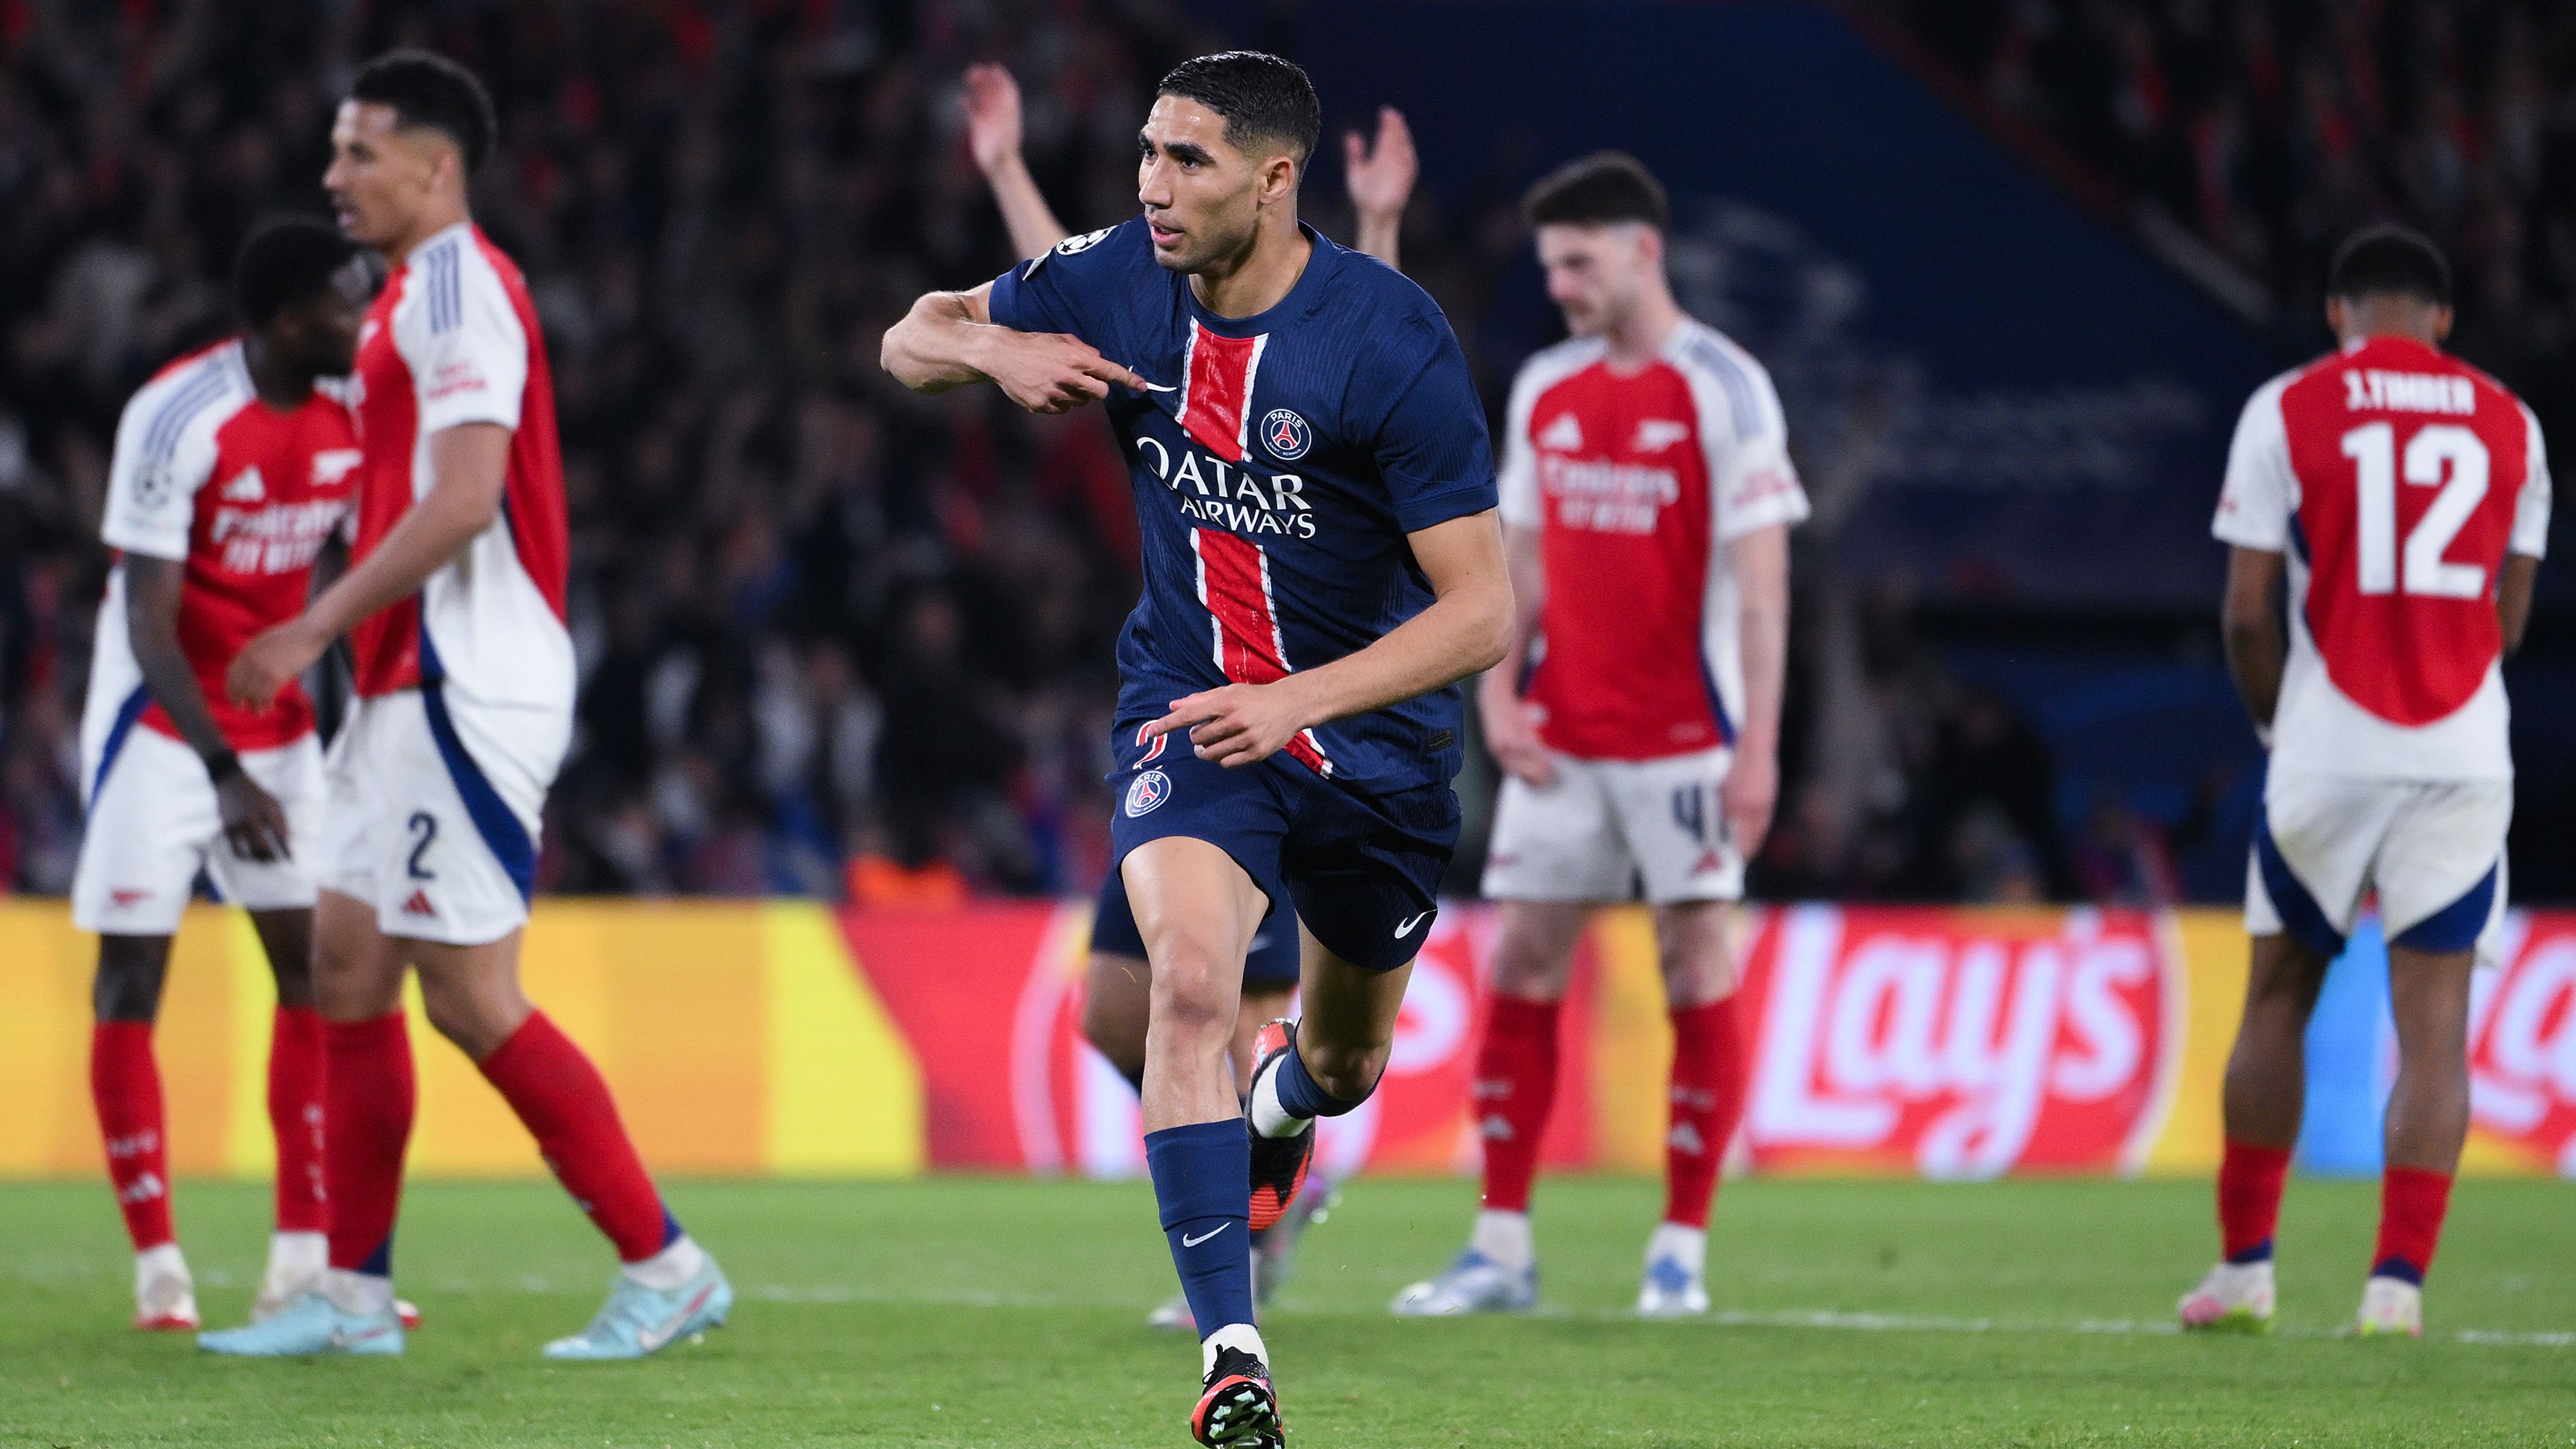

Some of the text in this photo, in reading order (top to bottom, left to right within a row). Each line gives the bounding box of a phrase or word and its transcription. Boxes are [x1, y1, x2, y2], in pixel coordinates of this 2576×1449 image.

[1270, 412, 1303, 428] PARIS
[1136, 437, 1312, 510] QATAR
[1180, 494, 1315, 539] AIRWAYS
[2341, 421, 2490, 600] 12
[1132, 720, 1168, 770] 2
[1132, 774, 1162, 791] PARIS
[408, 810, 438, 880] 2
[1741, 902, 2150, 1180] Lay's
